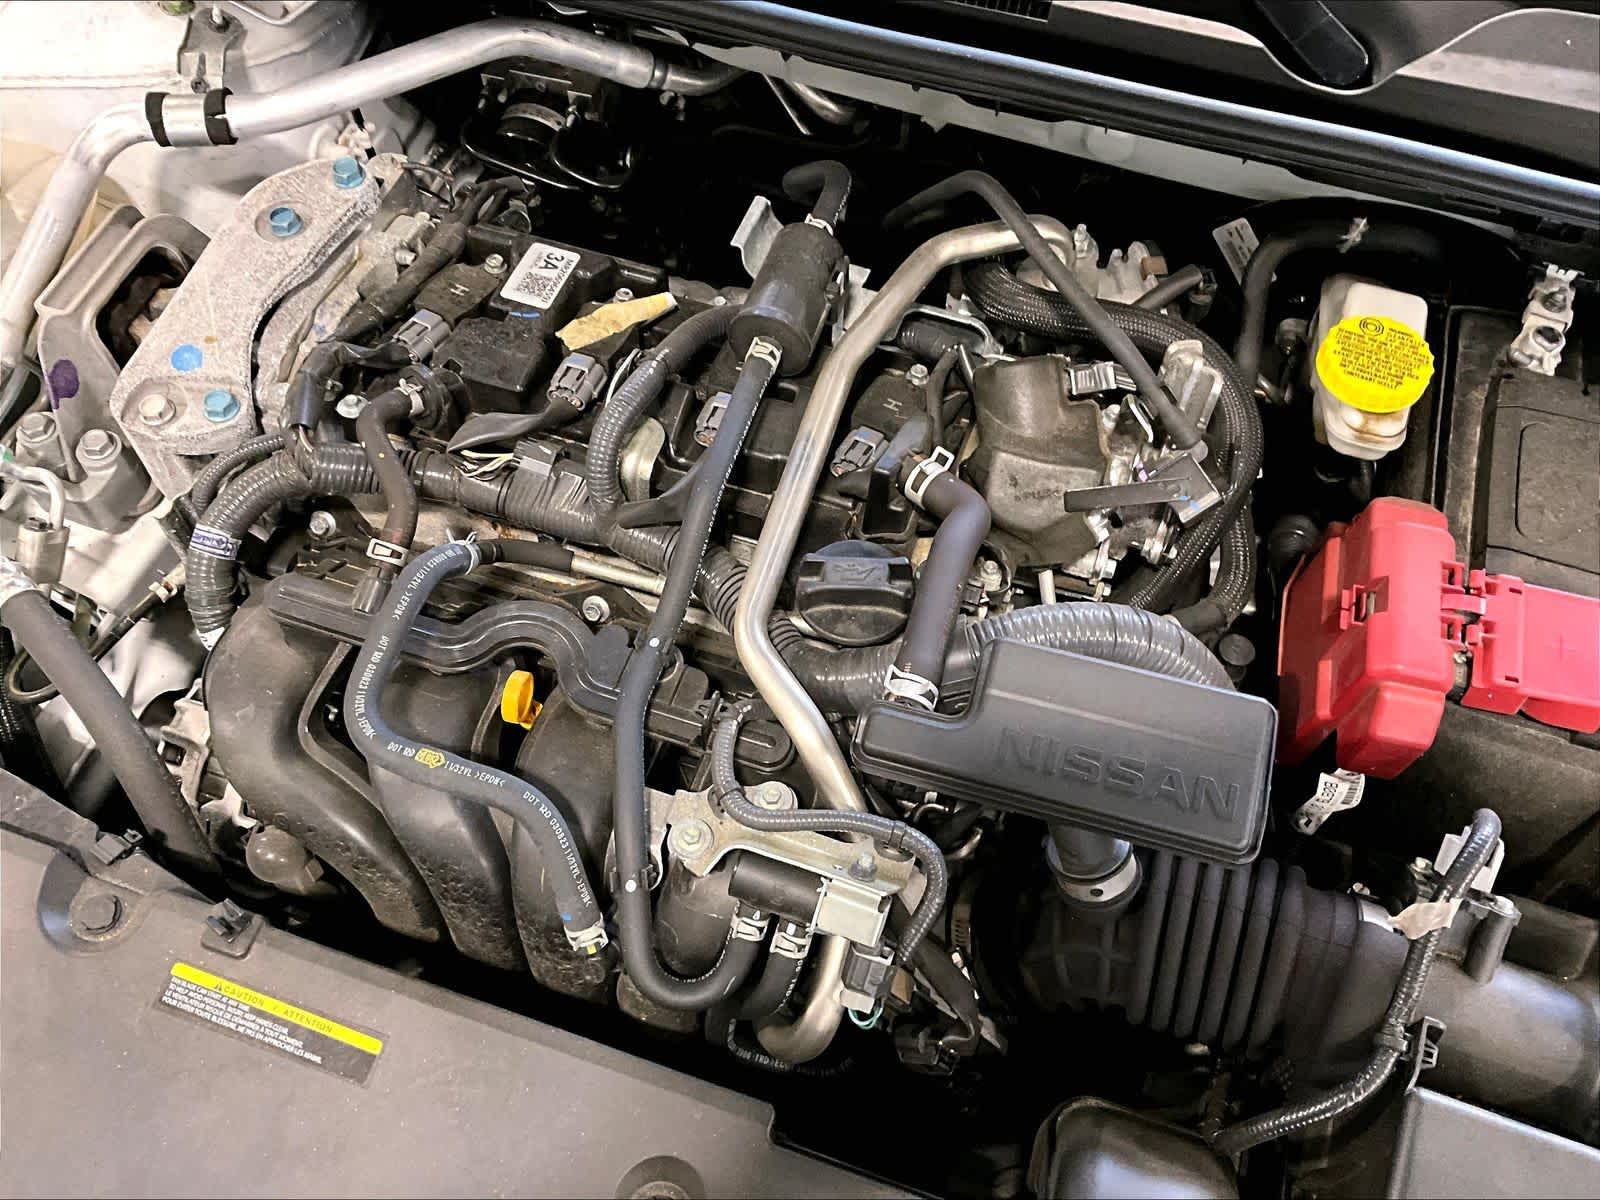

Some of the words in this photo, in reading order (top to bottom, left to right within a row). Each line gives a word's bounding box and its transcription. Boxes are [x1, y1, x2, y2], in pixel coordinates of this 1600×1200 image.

[539, 252, 565, 270] 3A
[994, 726, 1241, 822] NISSAN
[523, 791, 540, 806] DOT
[550, 818, 568, 849] 030823
[223, 985, 265, 1007] CAUTION
[283, 1009, 333, 1033] ATTENTION
